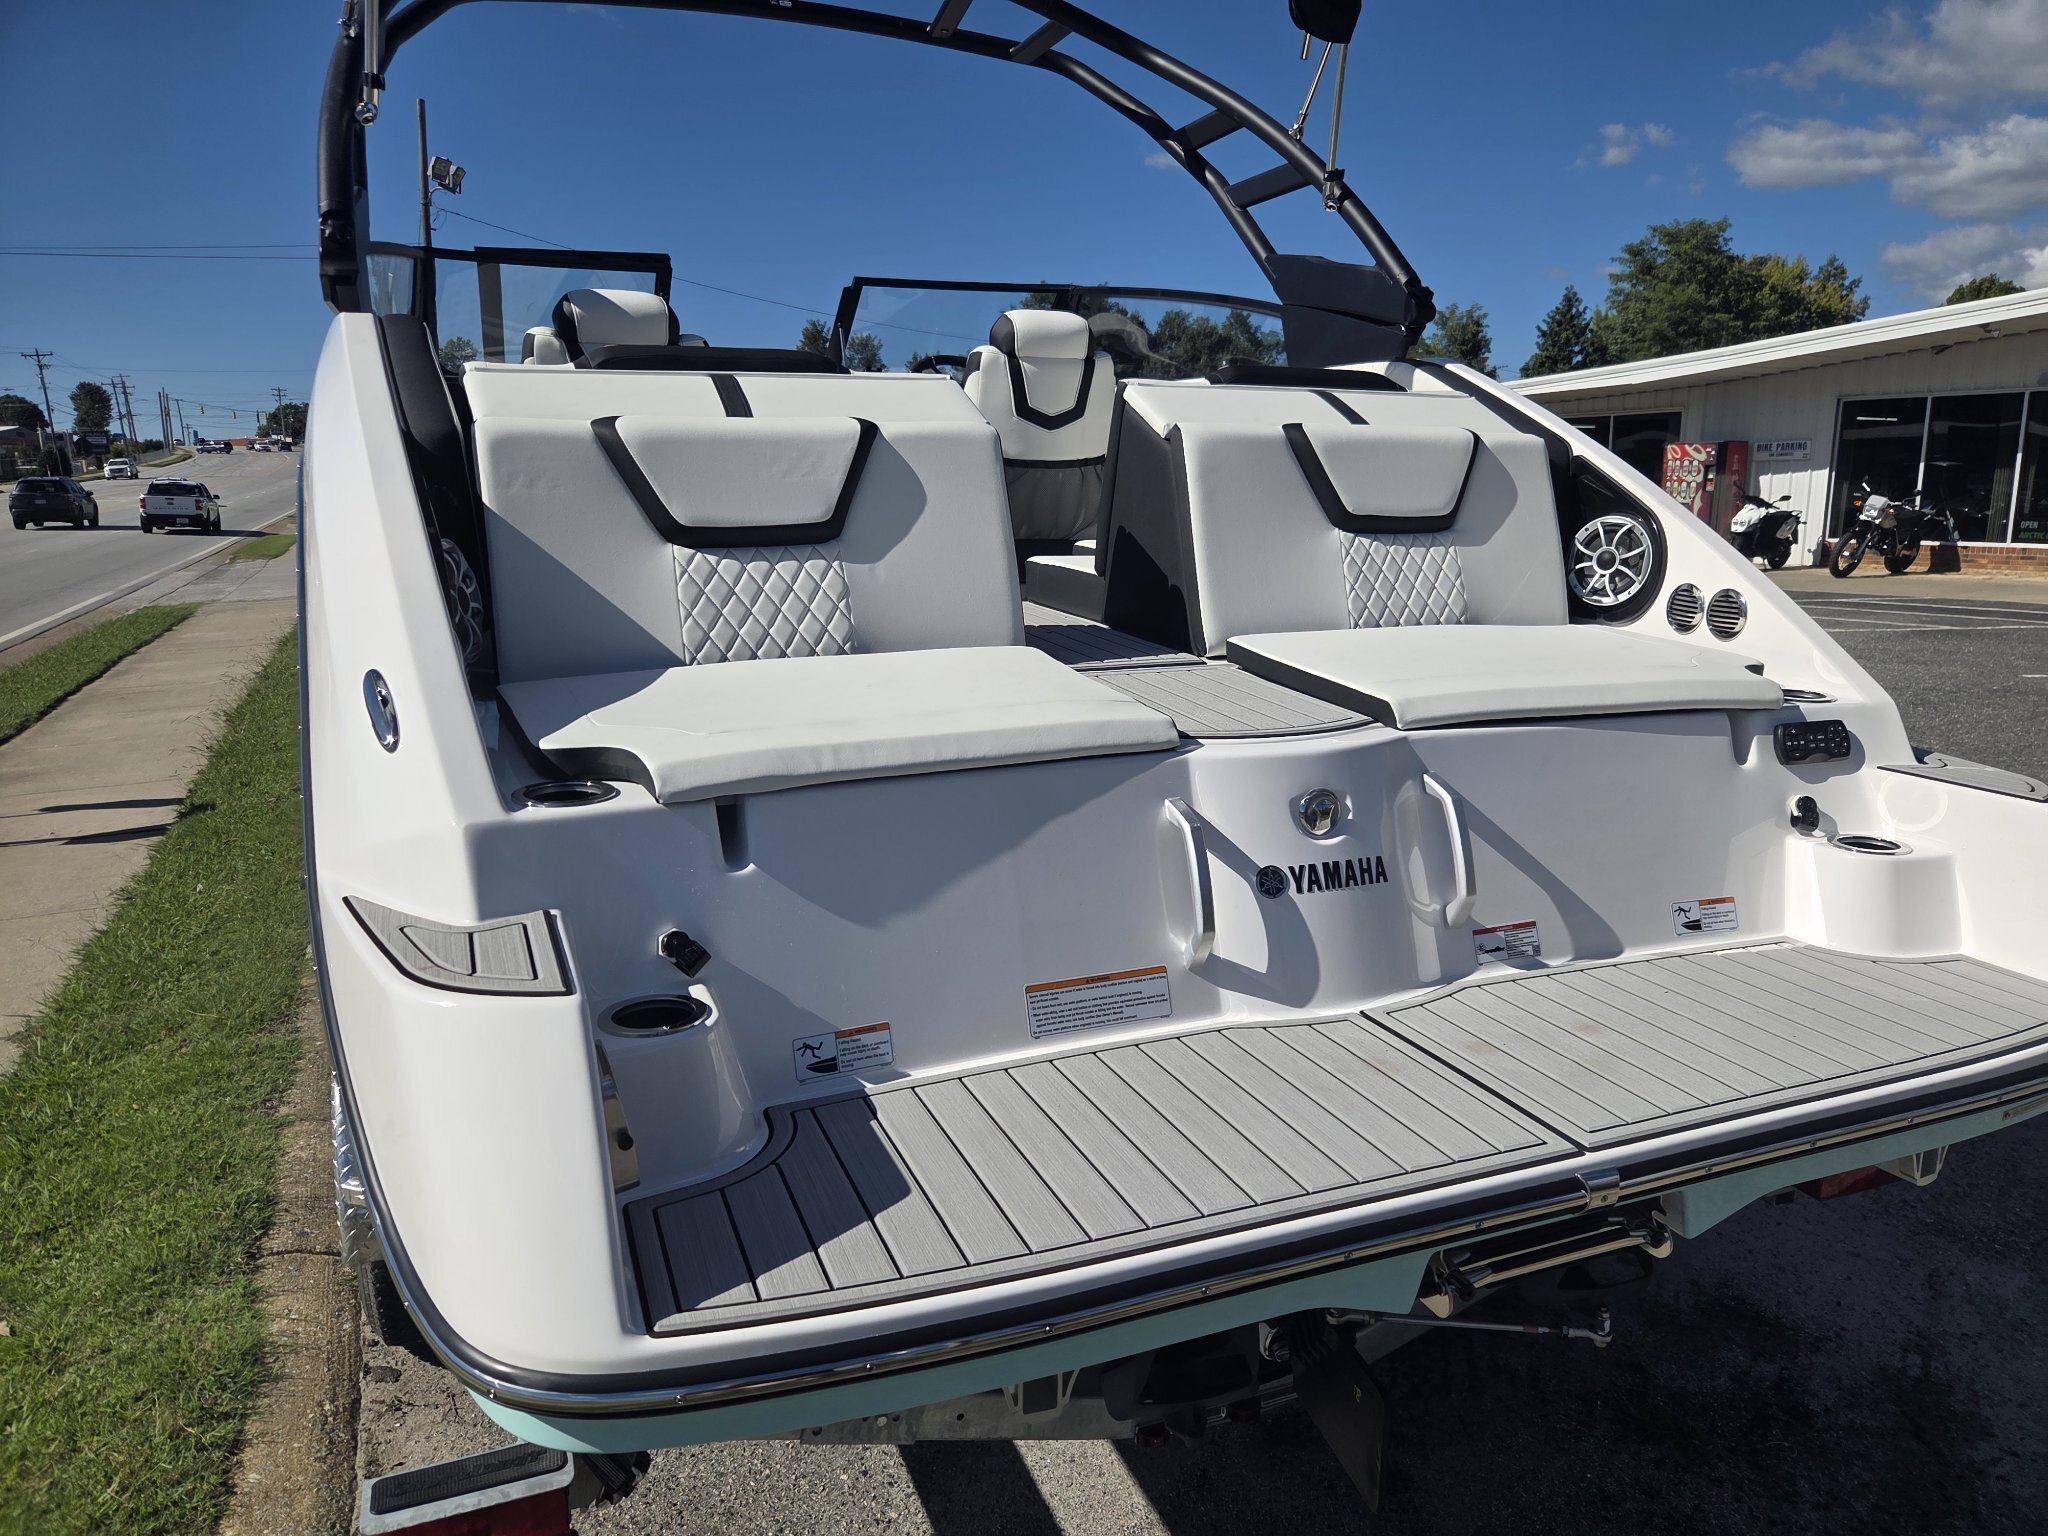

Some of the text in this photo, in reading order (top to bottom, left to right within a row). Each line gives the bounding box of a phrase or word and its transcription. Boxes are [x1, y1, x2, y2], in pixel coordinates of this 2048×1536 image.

[1757, 441, 1808, 453] BIKE PARKING
[2020, 520, 2039, 529] OPEN
[1288, 855, 1389, 894] YAMAHA
